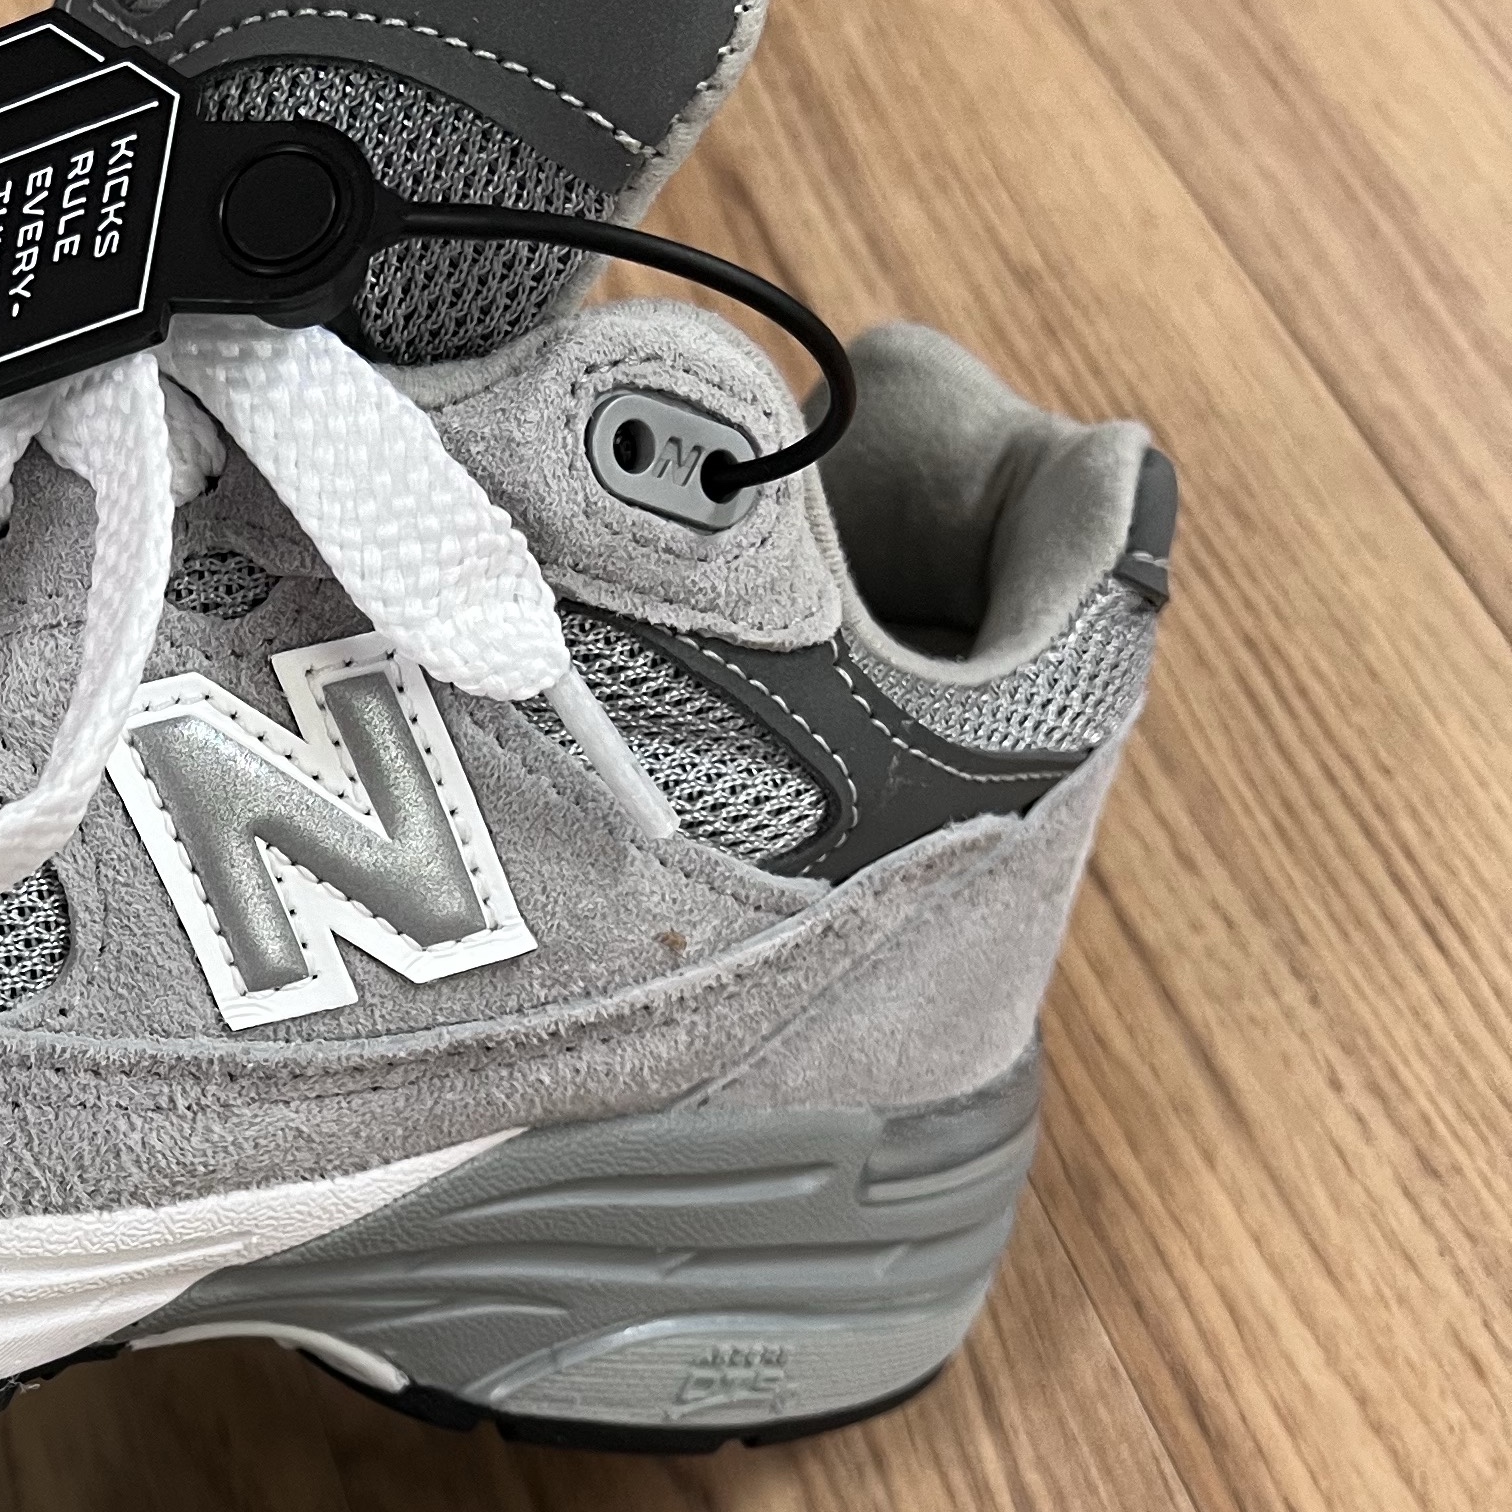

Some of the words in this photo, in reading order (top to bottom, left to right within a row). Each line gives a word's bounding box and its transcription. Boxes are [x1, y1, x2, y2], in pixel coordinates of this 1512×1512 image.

[8, 165, 54, 318] EVERY-
[52, 149, 95, 264] RULE
[94, 133, 138, 259] KICKS
[106, 632, 538, 1030] N
